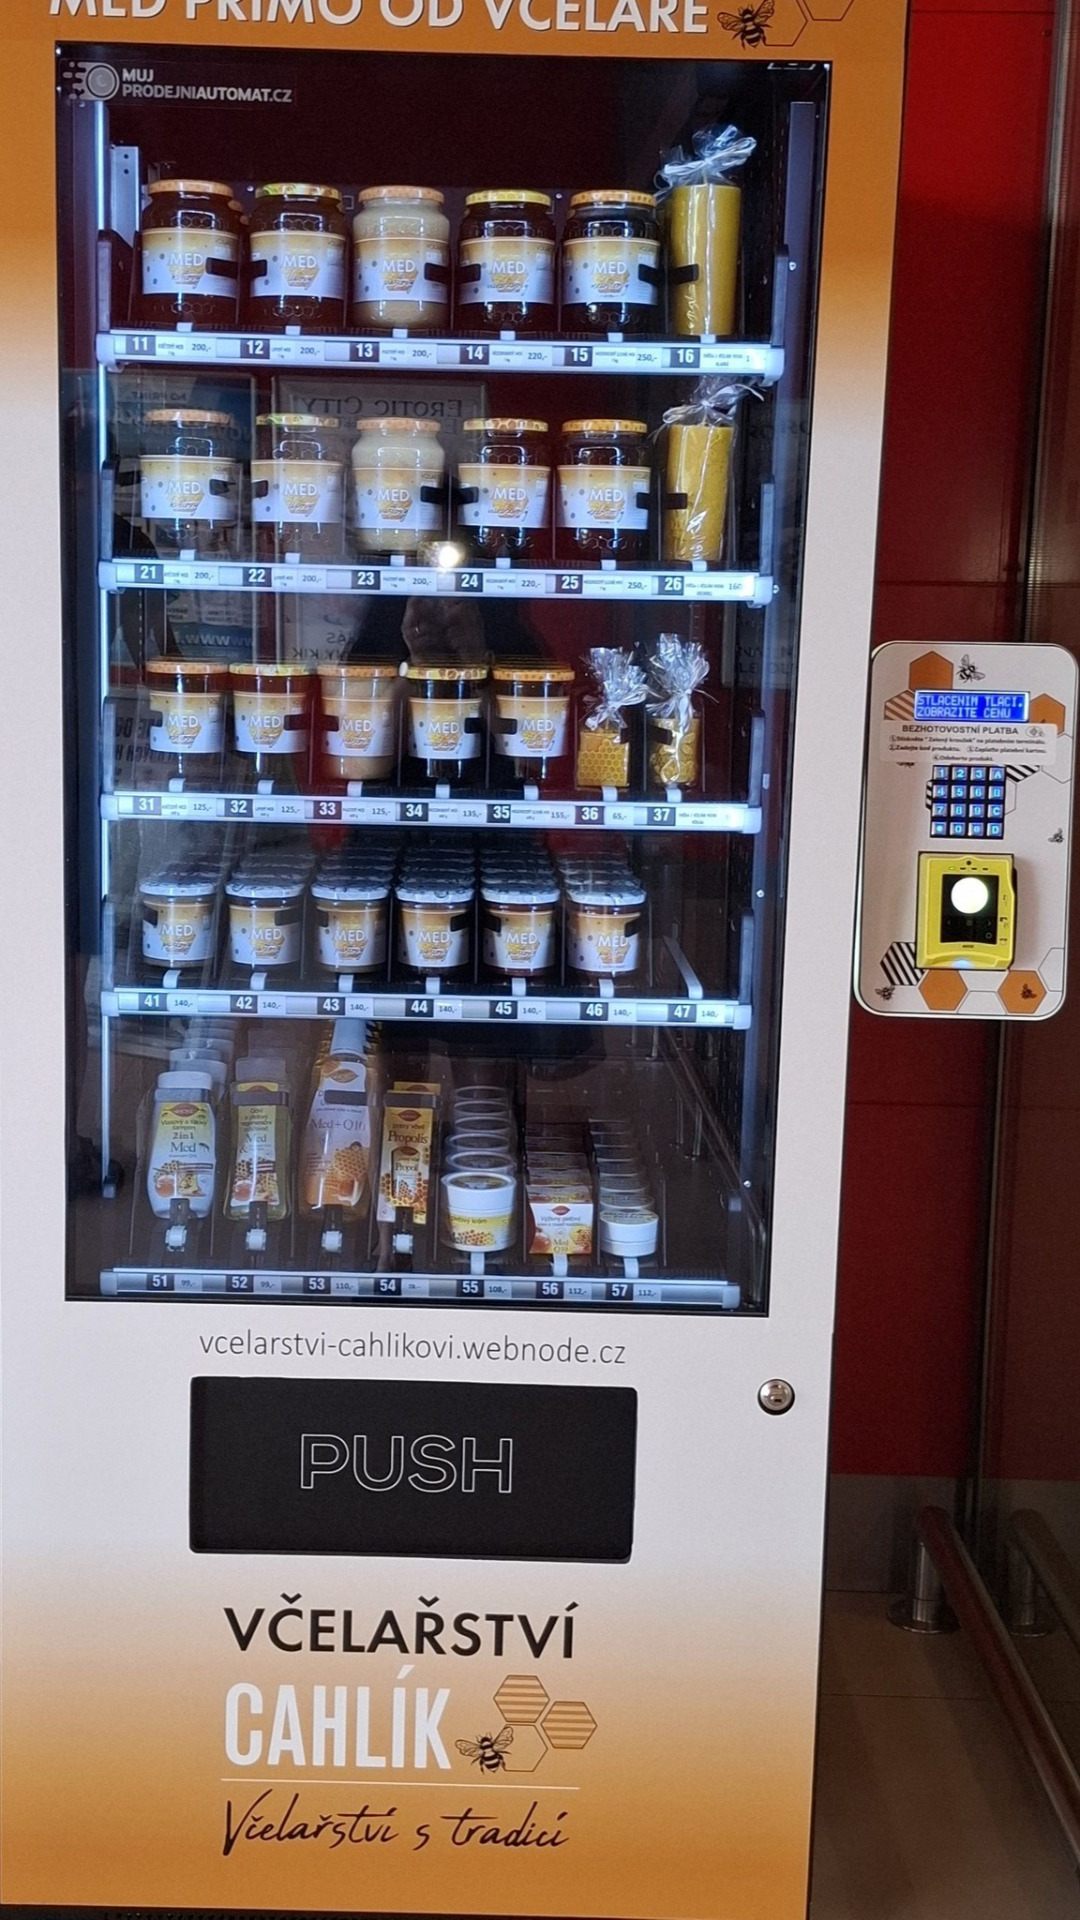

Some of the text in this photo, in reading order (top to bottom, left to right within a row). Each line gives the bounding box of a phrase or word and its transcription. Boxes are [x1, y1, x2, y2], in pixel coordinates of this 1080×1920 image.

[122, 84, 293, 103] PRODEJNIAUTOMAT.CZ
[169, 253, 204, 267] MED
[282, 255, 317, 268] MED
[382, 260, 416, 273] MED
[492, 261, 526, 274] MED
[593, 261, 628, 274] MED
[132, 337, 148, 351] 11
[191, 343, 212, 352] 200,-
[247, 340, 264, 354] 12
[300, 346, 320, 356] 200,-
[356, 343, 373, 358] 13
[412, 349, 432, 358] 200,-
[466, 346, 484, 360] 14
[527, 352, 548, 361] 220,-
[571, 348, 588, 362] 15
[636, 353, 658, 362] 250,-
[677, 349, 694, 364] 16
[167, 481, 201, 494] MED
[284, 483, 318, 496] MED
[493, 487, 527, 501] MED
[377, 488, 410, 502] MED
[590, 489, 624, 502] MED
[140, 566, 157, 579] 21
[194, 571, 214, 580] 200,-
[248, 568, 266, 583] 22
[302, 574, 322, 583] 200,-
[357, 572, 374, 586] 23
[412, 578, 432, 586] 200,-
[461, 574, 478, 588] 24
[521, 580, 541, 588] 220,-
[561, 576, 578, 590] 25
[627, 582, 648, 591] 250,-
[664, 577, 682, 591] 26
[917, 695, 978, 706] STLACENIM
[916, 706, 1010, 718] ZOBRAZITE CENU
[168, 715, 199, 728] MED
[250, 715, 282, 728] MED
[341, 718, 373, 732] MED
[428, 721, 460, 734] MED
[522, 718, 554, 732] MED
[902, 724, 1018, 735] BEZHOTOVOSTNÍ PLATBA
[138, 798, 155, 812] 31
[193, 804, 212, 812] 125,-
[230, 800, 248, 814] 32
[281, 806, 300, 814] 125,-
[319, 802, 336, 816] 33
[372, 808, 392, 816] 125,-
[406, 804, 423, 818] 34
[462, 810, 482, 818] 135,-
[492, 806, 510, 819] 35
[581, 806, 628, 820] 36 65,-
[653, 808, 670, 822] 37
[161, 924, 194, 936] MED
[252, 928, 283, 941] MED
[334, 929, 366, 942] MED
[418, 931, 450, 943] MED
[506, 932, 538, 944] MED
[598, 934, 629, 948] MED
[144, 994, 194, 1008] 41 140,-
[236, 996, 282, 1010] 42 140,-
[322, 998, 370, 1012] 43 140,-
[410, 1000, 458, 1014] 44 140,-
[494, 1002, 542, 1015] 45 140,-
[586, 1004, 632, 1017] 46 140,-
[673, 1004, 720, 1018] 47 140,-
[388, 1130, 428, 1145] Propolis
[170, 1141, 196, 1152] Med
[152, 1275, 168, 1288] 51
[231, 1276, 248, 1289] 52
[309, 1278, 354, 1290] 53 110,-
[380, 1279, 396, 1292] 54
[462, 1280, 479, 1294] 55
[542, 1282, 558, 1295] 56
[612, 1284, 628, 1296] 57
[199, 1329, 627, 1365] vcelarstvi-cahlikovi.webnode.cz
[300, 1433, 513, 1494] PUSH
[223, 1592, 580, 1659] VČELAŘSTVÍ
[225, 1664, 452, 1770] CAHLÍK
[222, 1788, 400, 1856] Včelařství
[412, 1824, 431, 1852] s
